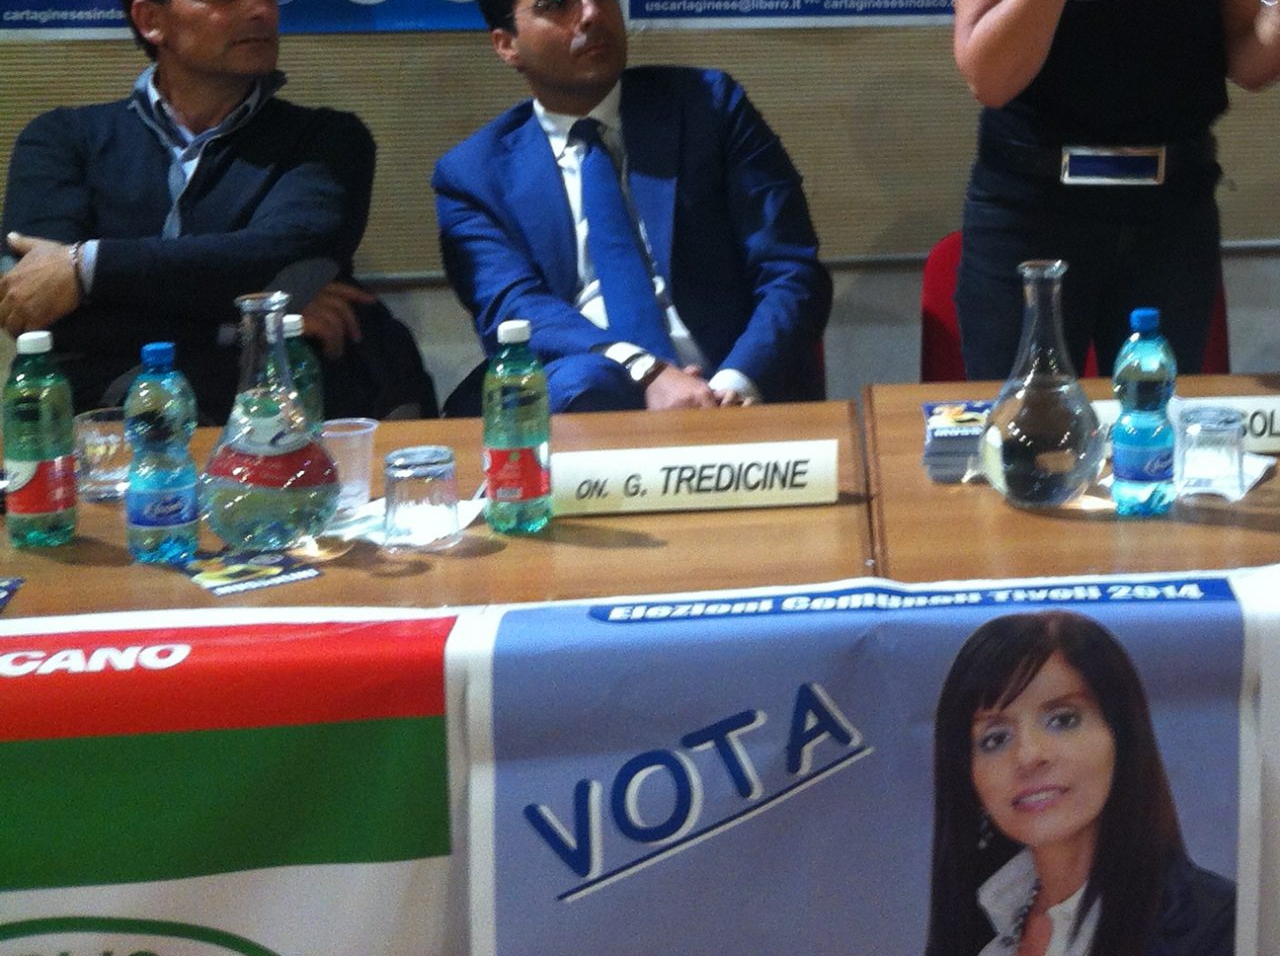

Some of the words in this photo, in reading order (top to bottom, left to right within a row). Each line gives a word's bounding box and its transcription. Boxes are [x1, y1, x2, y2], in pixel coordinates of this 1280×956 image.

[3, 8, 126, 23] cartaginesesinda
[576, 477, 608, 500] ON.
[623, 474, 648, 498] G.
[660, 459, 810, 496] TREDICINE
[607, 599, 774, 622] Elezioni
[0, 644, 193, 678] CANO
[524, 681, 864, 879] VOTA
